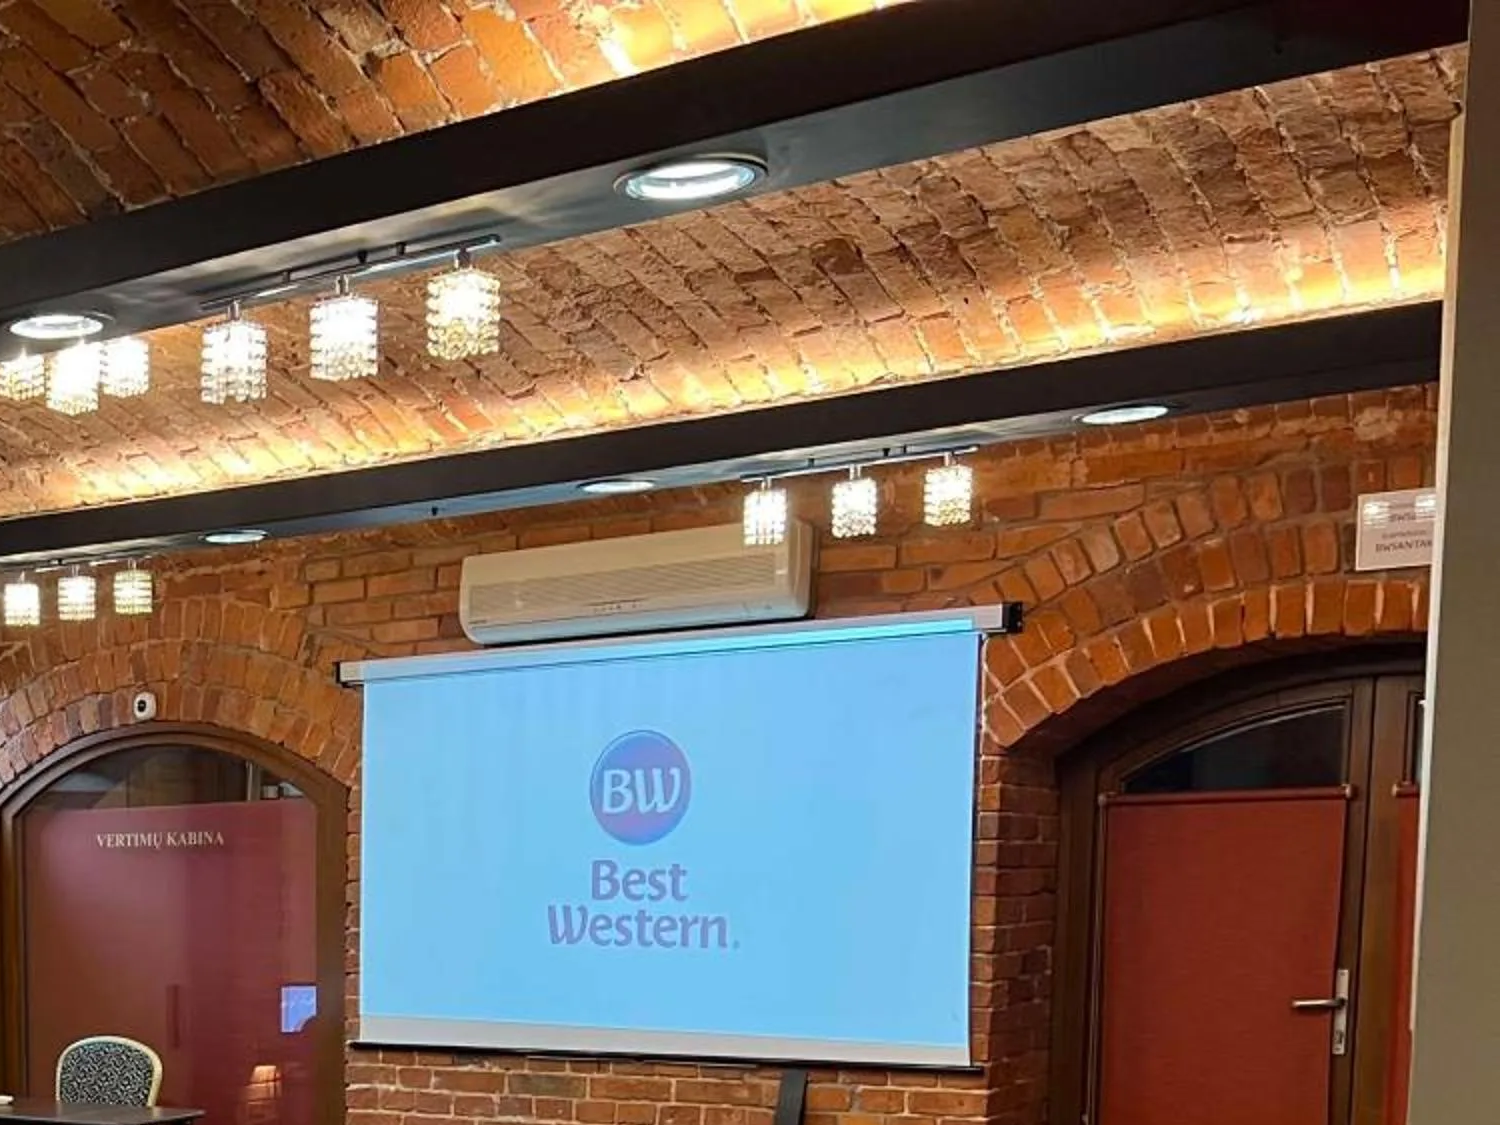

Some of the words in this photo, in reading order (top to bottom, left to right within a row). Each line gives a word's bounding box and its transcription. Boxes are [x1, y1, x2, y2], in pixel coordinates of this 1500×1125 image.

[602, 767, 681, 814] BW
[96, 832, 163, 850] VERTIMŲ
[167, 831, 225, 847] KABINA
[591, 859, 689, 902] Best
[547, 904, 729, 948] Western
